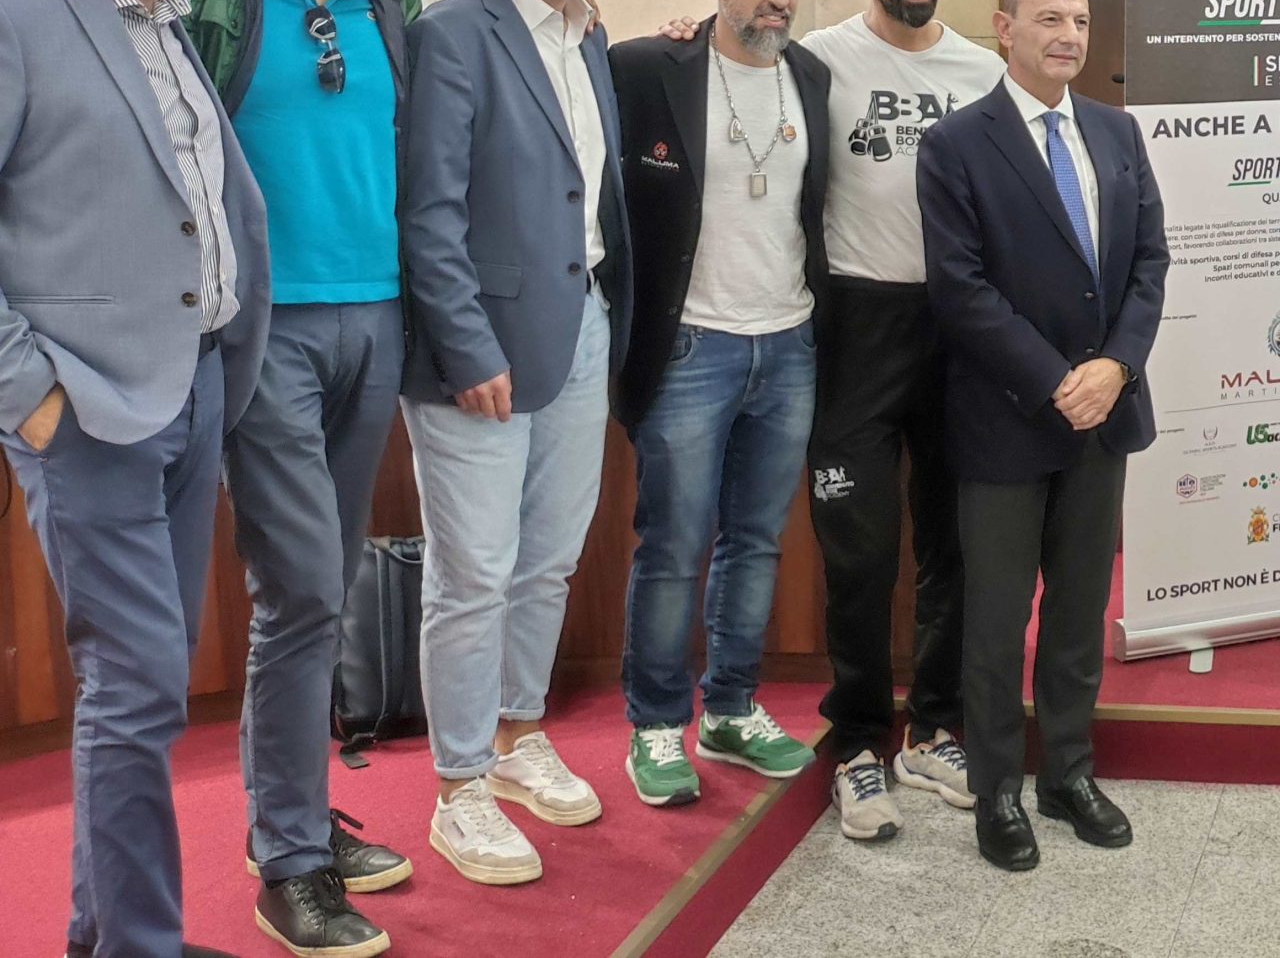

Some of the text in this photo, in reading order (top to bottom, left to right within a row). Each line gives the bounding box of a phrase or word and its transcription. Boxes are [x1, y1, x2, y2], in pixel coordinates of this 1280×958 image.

[1147, 35, 1162, 44] UN
[1164, 33, 1225, 44] INTERVENTO
[1226, 33, 1244, 42] PER
[1265, 75, 1273, 86] E
[1152, 115, 1245, 139] ANCHE
[1253, 114, 1272, 134] A
[1222, 252, 1240, 261] corsi
[1241, 251, 1249, 259] di
[1250, 250, 1273, 258] difesa
[1212, 263, 1232, 273] Spazi
[1233, 260, 1269, 270] comunali
[1233, 270, 1269, 280] educativi
[1147, 587, 1168, 601] LO
[1170, 579, 1221, 598] SPORT
[1223, 573, 1257, 590] NON
[1260, 568, 1270, 584] È
